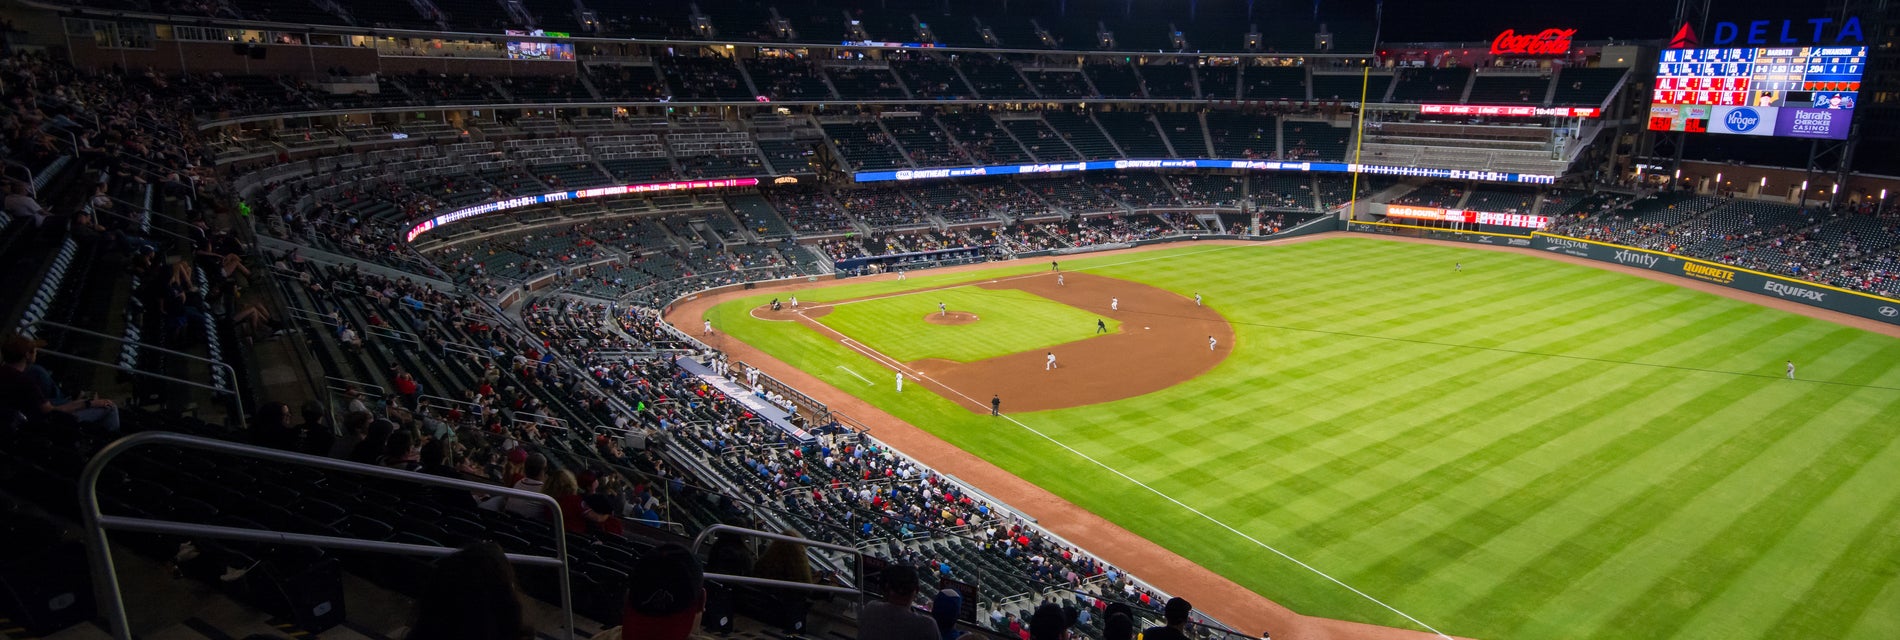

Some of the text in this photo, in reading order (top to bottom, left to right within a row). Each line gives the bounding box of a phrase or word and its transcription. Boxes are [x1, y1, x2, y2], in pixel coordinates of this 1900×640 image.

[1713, 16, 1864, 44] DELTA
[1490, 28, 1577, 54] Coca-Cola
[1664, 50, 1676, 61] NL
[1659, 78, 1671, 89] AL
[1728, 111, 1757, 130] Kroger
[1795, 110, 1832, 120] Harrah's
[1128, 160, 1162, 168] SOUTHEAST
[913, 169, 950, 178] SOUTHEAST
[1412, 209, 1438, 218] SOUTH
[1546, 237, 1589, 249] WELLSTAR
[1614, 250, 1659, 269] xfinity
[1683, 261, 1735, 281] QUIKRETE
[1763, 280, 1826, 302] EQUIFAX
